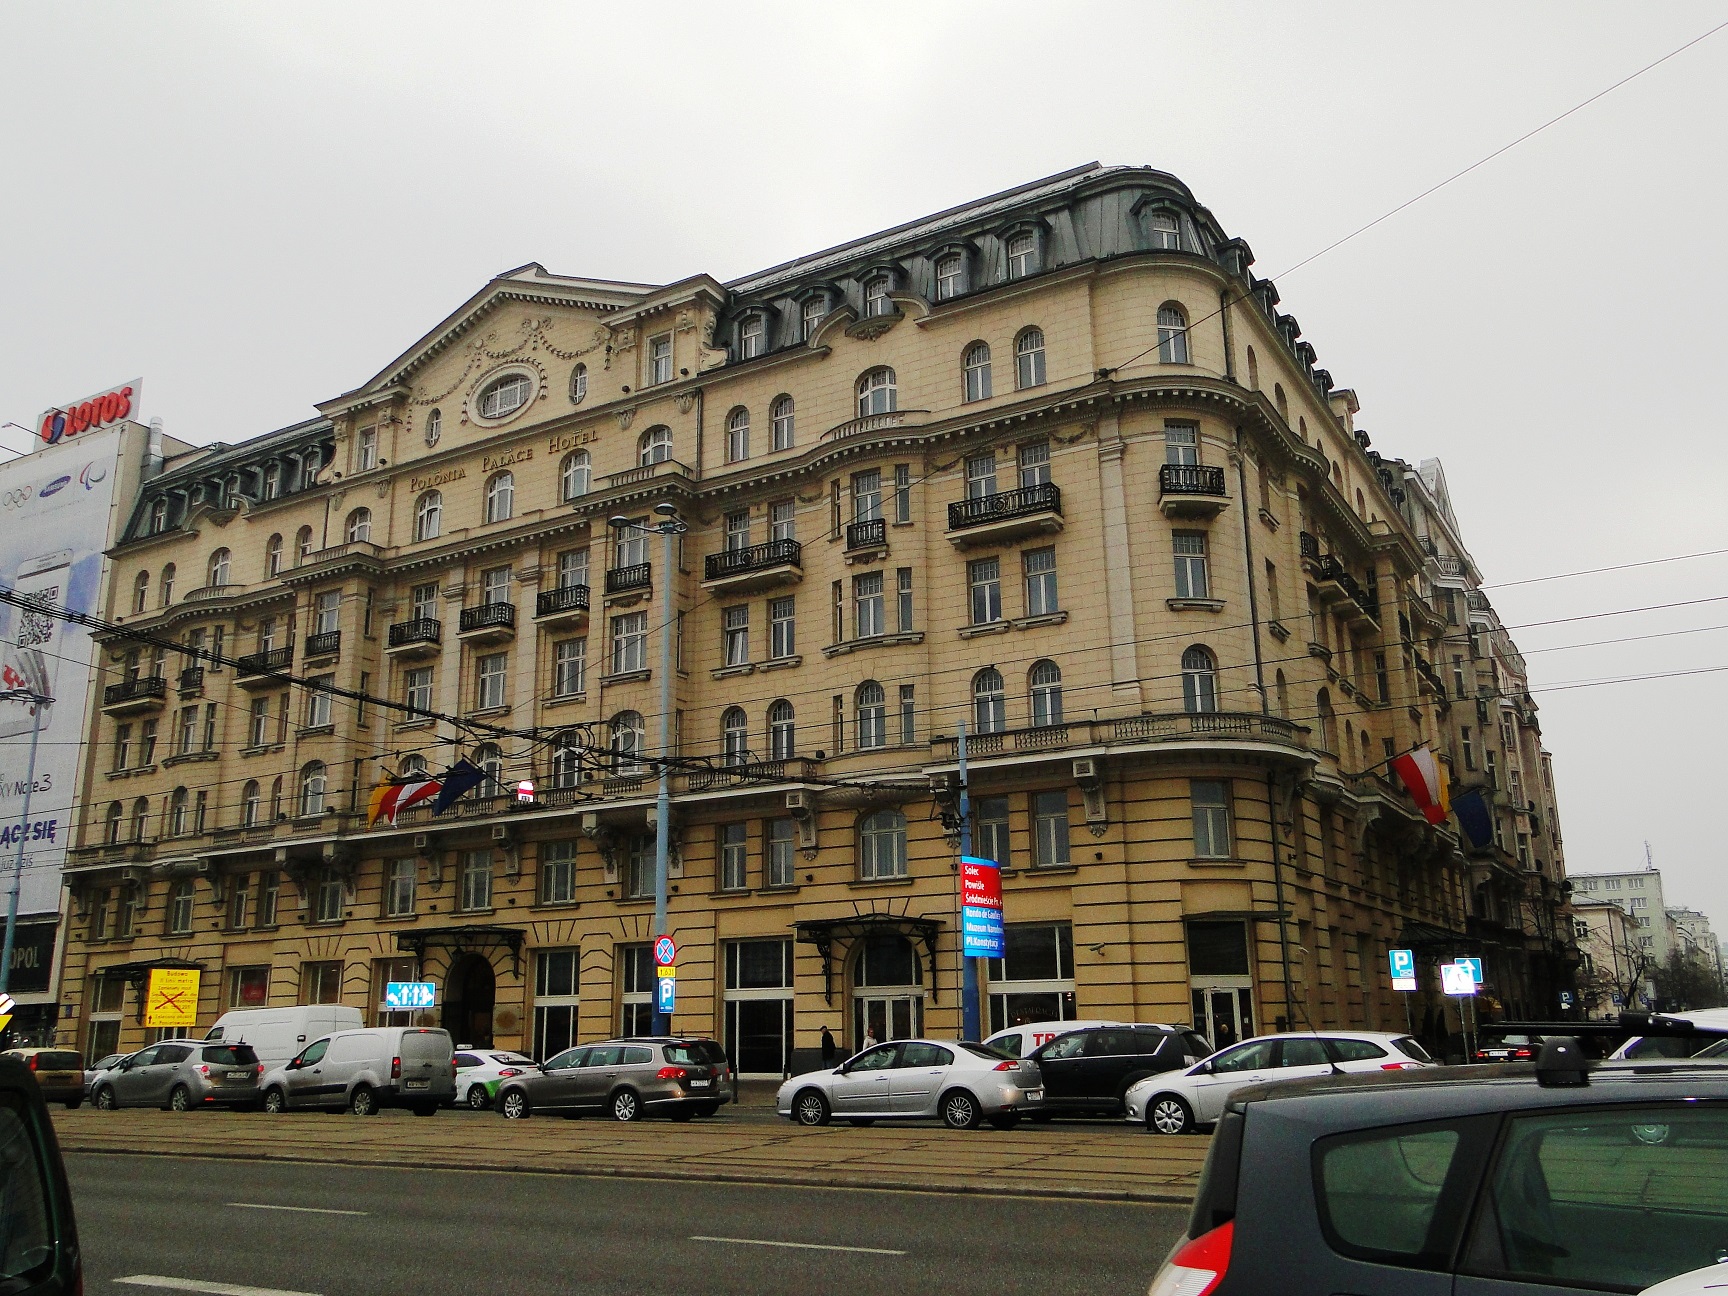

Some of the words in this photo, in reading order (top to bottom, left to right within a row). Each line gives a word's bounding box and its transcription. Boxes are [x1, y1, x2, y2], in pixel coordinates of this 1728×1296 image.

[65, 387, 133, 437] LOTOS
[482, 448, 533, 473] PALACE
[548, 430, 599, 454] HOTEL
[14, 779, 40, 796] Noe
[32, 819, 57, 844] SIĘ
[965, 865, 979, 876] Solec
[965, 880, 985, 890] Powiśle
[966, 908, 982, 918] Rondo
[966, 922, 986, 932] Muzeum
[1394, 952, 1408, 970] P
[662, 984, 672, 1003] P
